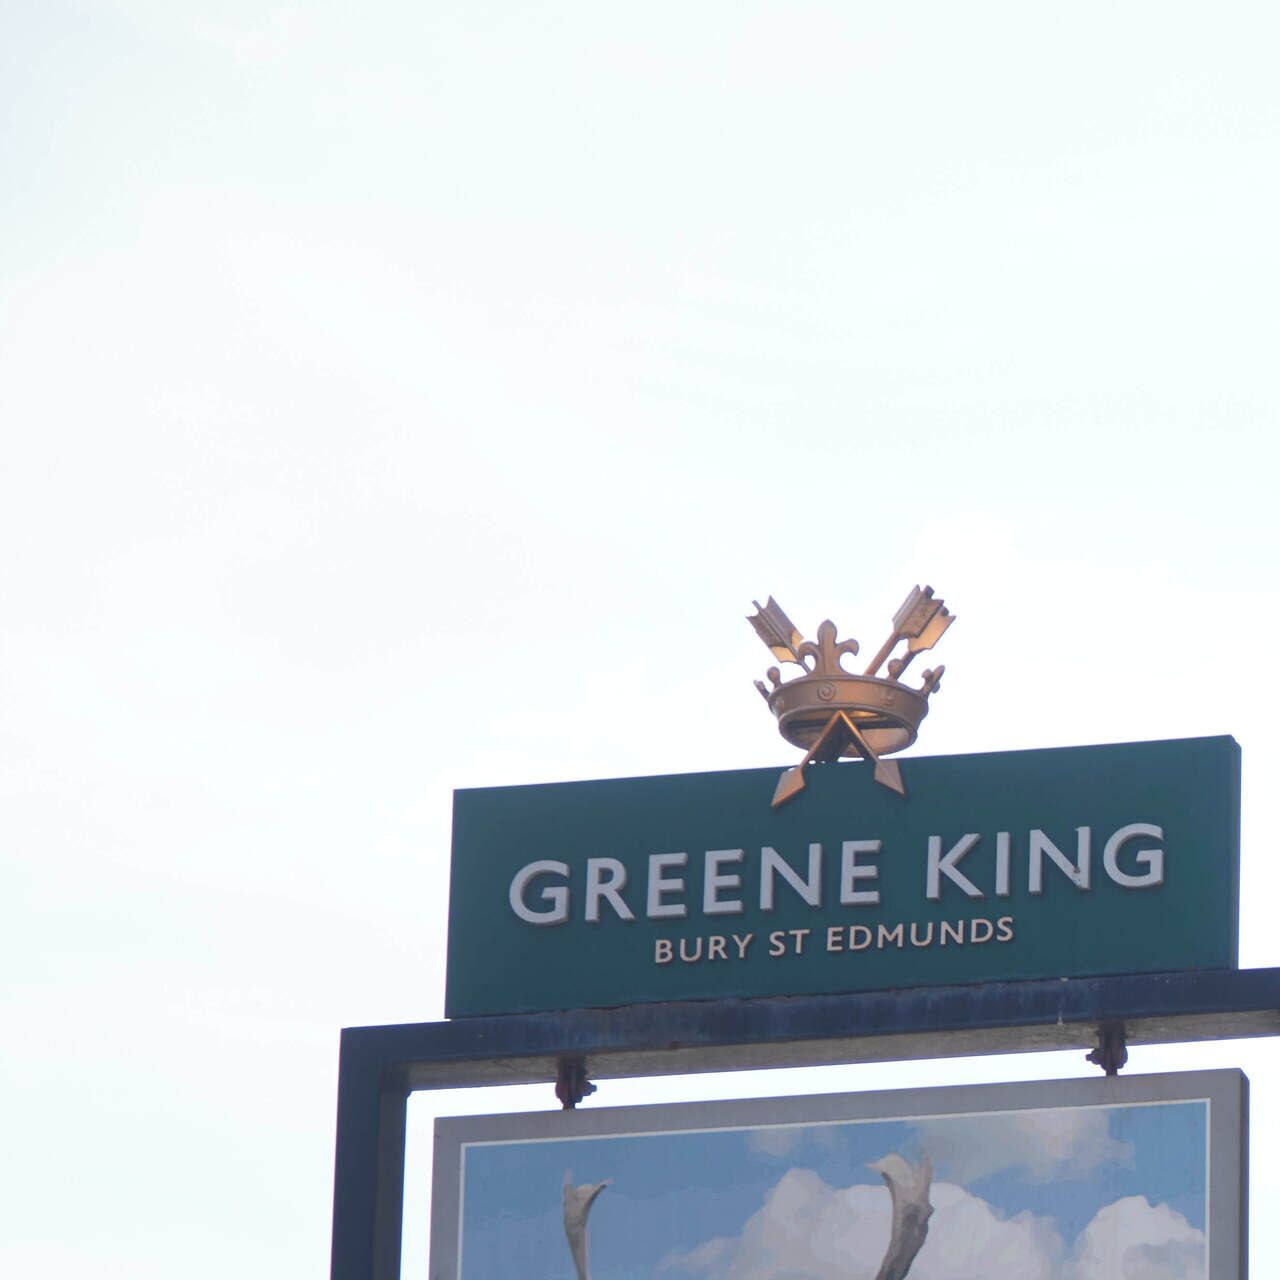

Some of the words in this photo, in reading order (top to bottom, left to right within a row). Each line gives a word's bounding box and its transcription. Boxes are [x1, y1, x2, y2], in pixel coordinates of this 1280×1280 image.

[508, 838, 884, 927] GREENE
[925, 822, 1166, 900] KING
[653, 932, 754, 965] BURY
[768, 927, 811, 958] ST
[825, 916, 1015, 953] EDMUNDS
